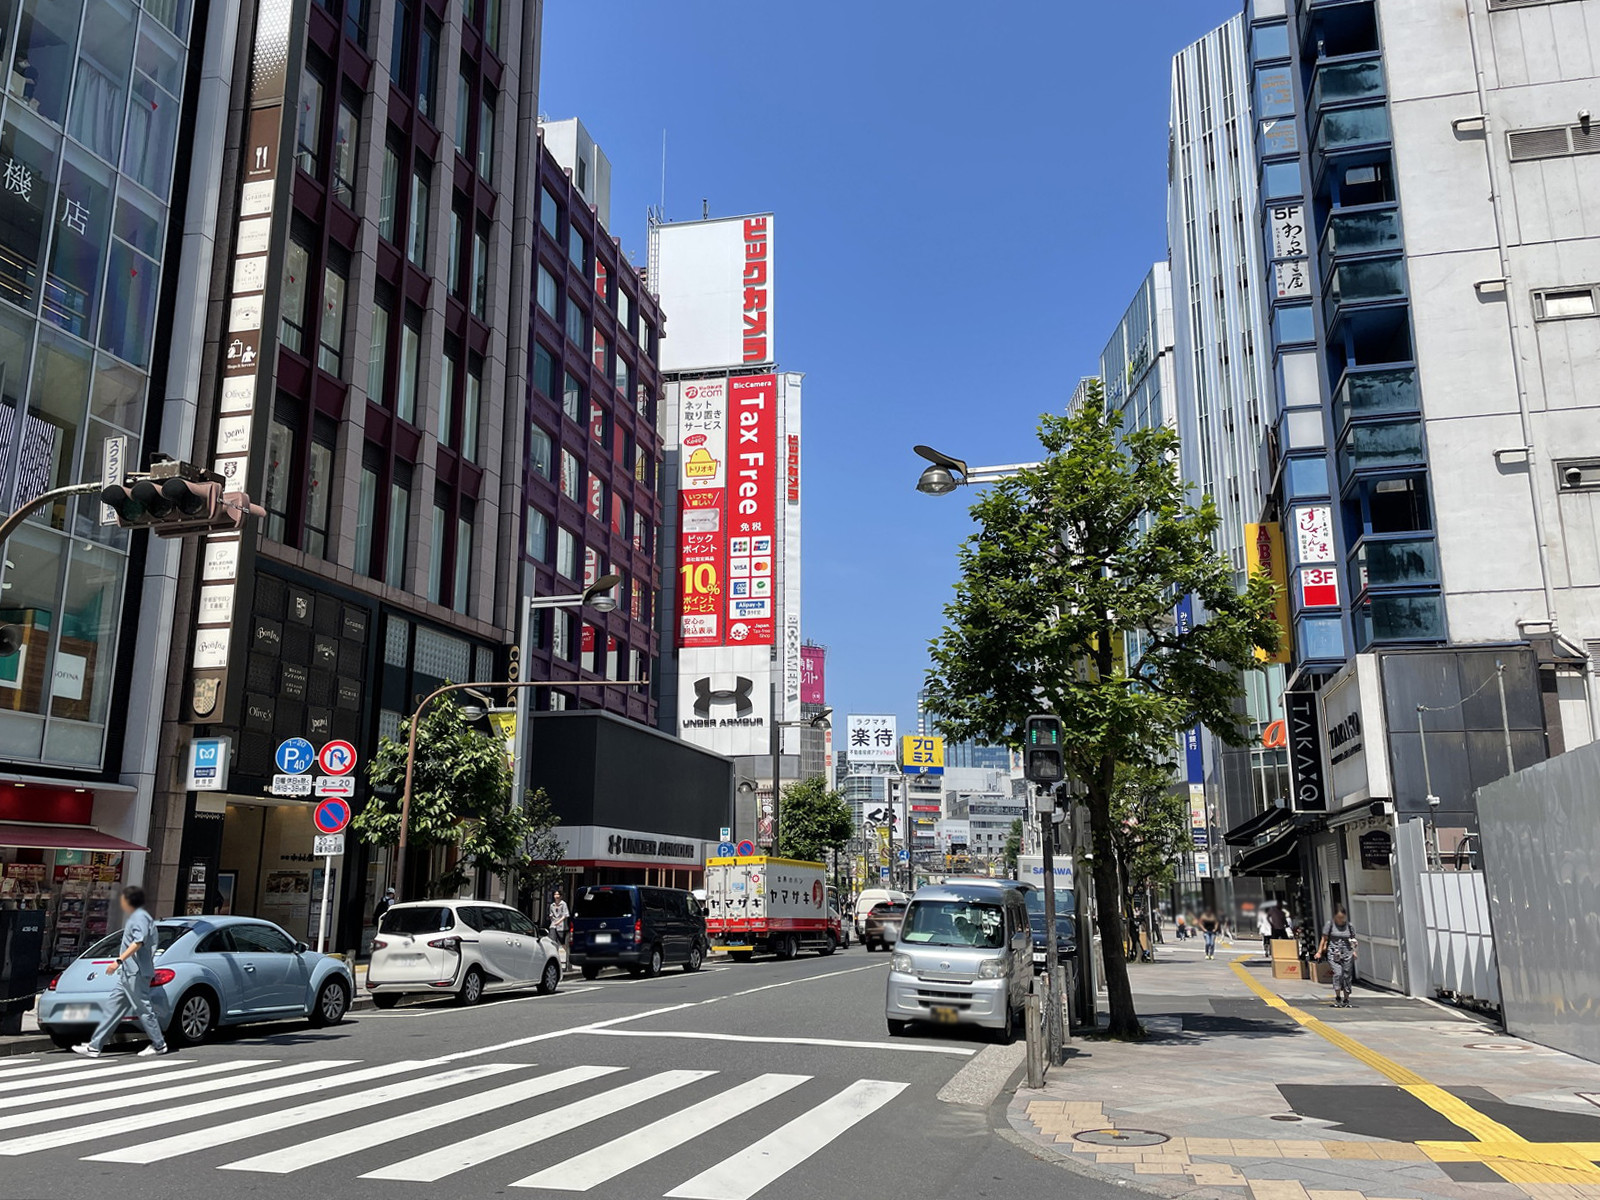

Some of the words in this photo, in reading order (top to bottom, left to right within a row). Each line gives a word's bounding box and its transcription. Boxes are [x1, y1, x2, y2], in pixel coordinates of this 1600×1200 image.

[1274, 206, 1298, 220] 5F
[734, 381, 772, 389] BicCamera
[685, 400, 712, 410] ネット
[685, 410, 722, 420] 取り置き
[740, 392, 764, 444] Tax
[684, 420, 722, 432] サービス
[689, 466, 714, 474] トリオキ
[739, 452, 764, 515] Free
[740, 522, 762, 532] 免税
[688, 534, 714, 544] ビック
[683, 544, 718, 554] ポイント
[1311, 568, 1334, 584] 3F
[684, 596, 716, 605] ポイント
[683, 604, 716, 614] サービス
[683, 718, 716, 728] UNDER
[720, 718, 764, 728] ARMOUR
[851, 728, 893, 747] 楽待
[913, 738, 934, 750] プロ
[284, 748, 300, 770] P
[913, 752, 934, 763] ミス
[294, 760, 304, 770] 40
[622, 838, 657, 856] UNDER
[658, 842, 694, 858] ARMOUR
[1032, 866, 1072, 876] SAAWA
[770, 889, 810, 904] ヤマザキ
[711, 898, 762, 908] ヤマザキ
